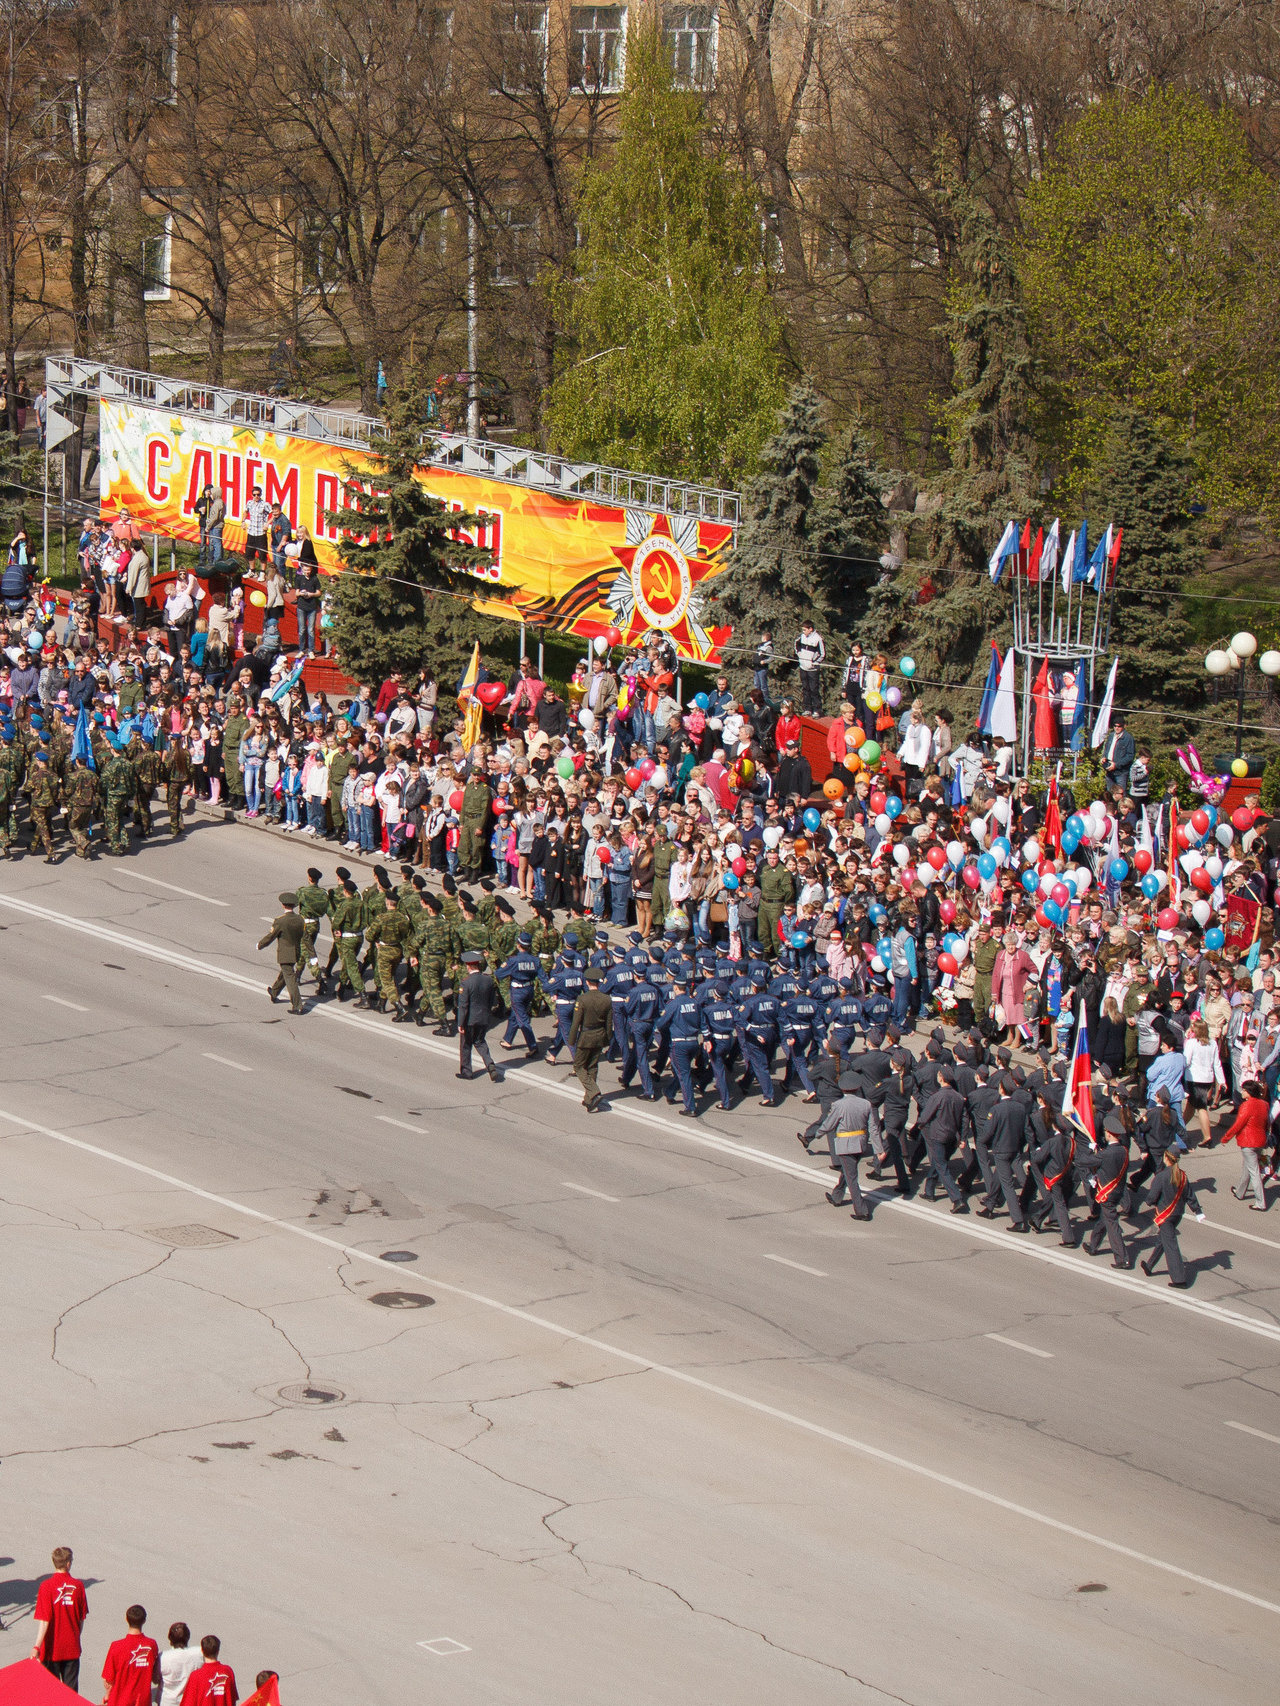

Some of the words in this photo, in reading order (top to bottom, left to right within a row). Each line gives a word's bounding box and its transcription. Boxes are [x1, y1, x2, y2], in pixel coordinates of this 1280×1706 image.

[147, 440, 170, 502] С
[184, 448, 299, 532] ДНЁМ
[633, 540, 686, 615] ОТЕЧЕСТВЕННАЯ
